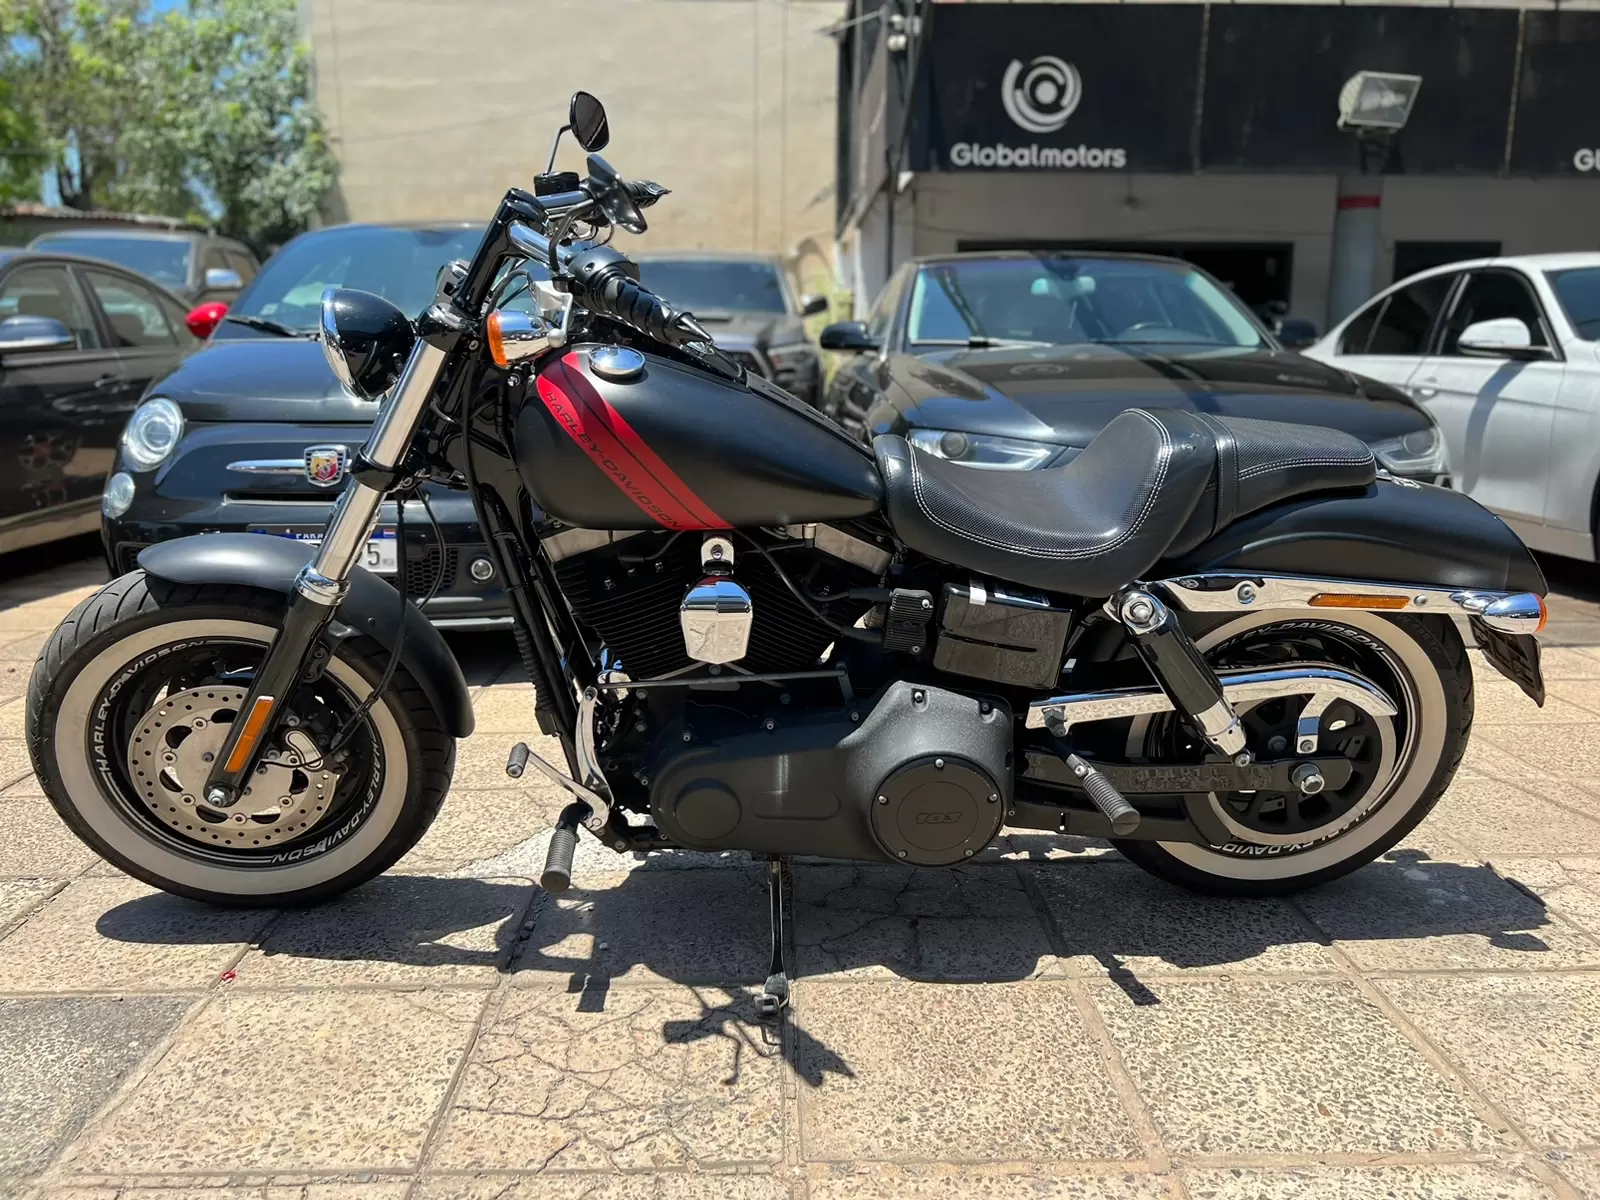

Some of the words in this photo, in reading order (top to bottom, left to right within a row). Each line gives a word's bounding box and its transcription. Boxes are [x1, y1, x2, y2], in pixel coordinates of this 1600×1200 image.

[950, 142, 1127, 168] Globalmotors
[546, 392, 682, 529] HARLEY-DAVIDSON
[94, 640, 205, 772] HARLEY-DAVIDSON
[272, 740, 381, 864] HARLEY-DAVIDSON
